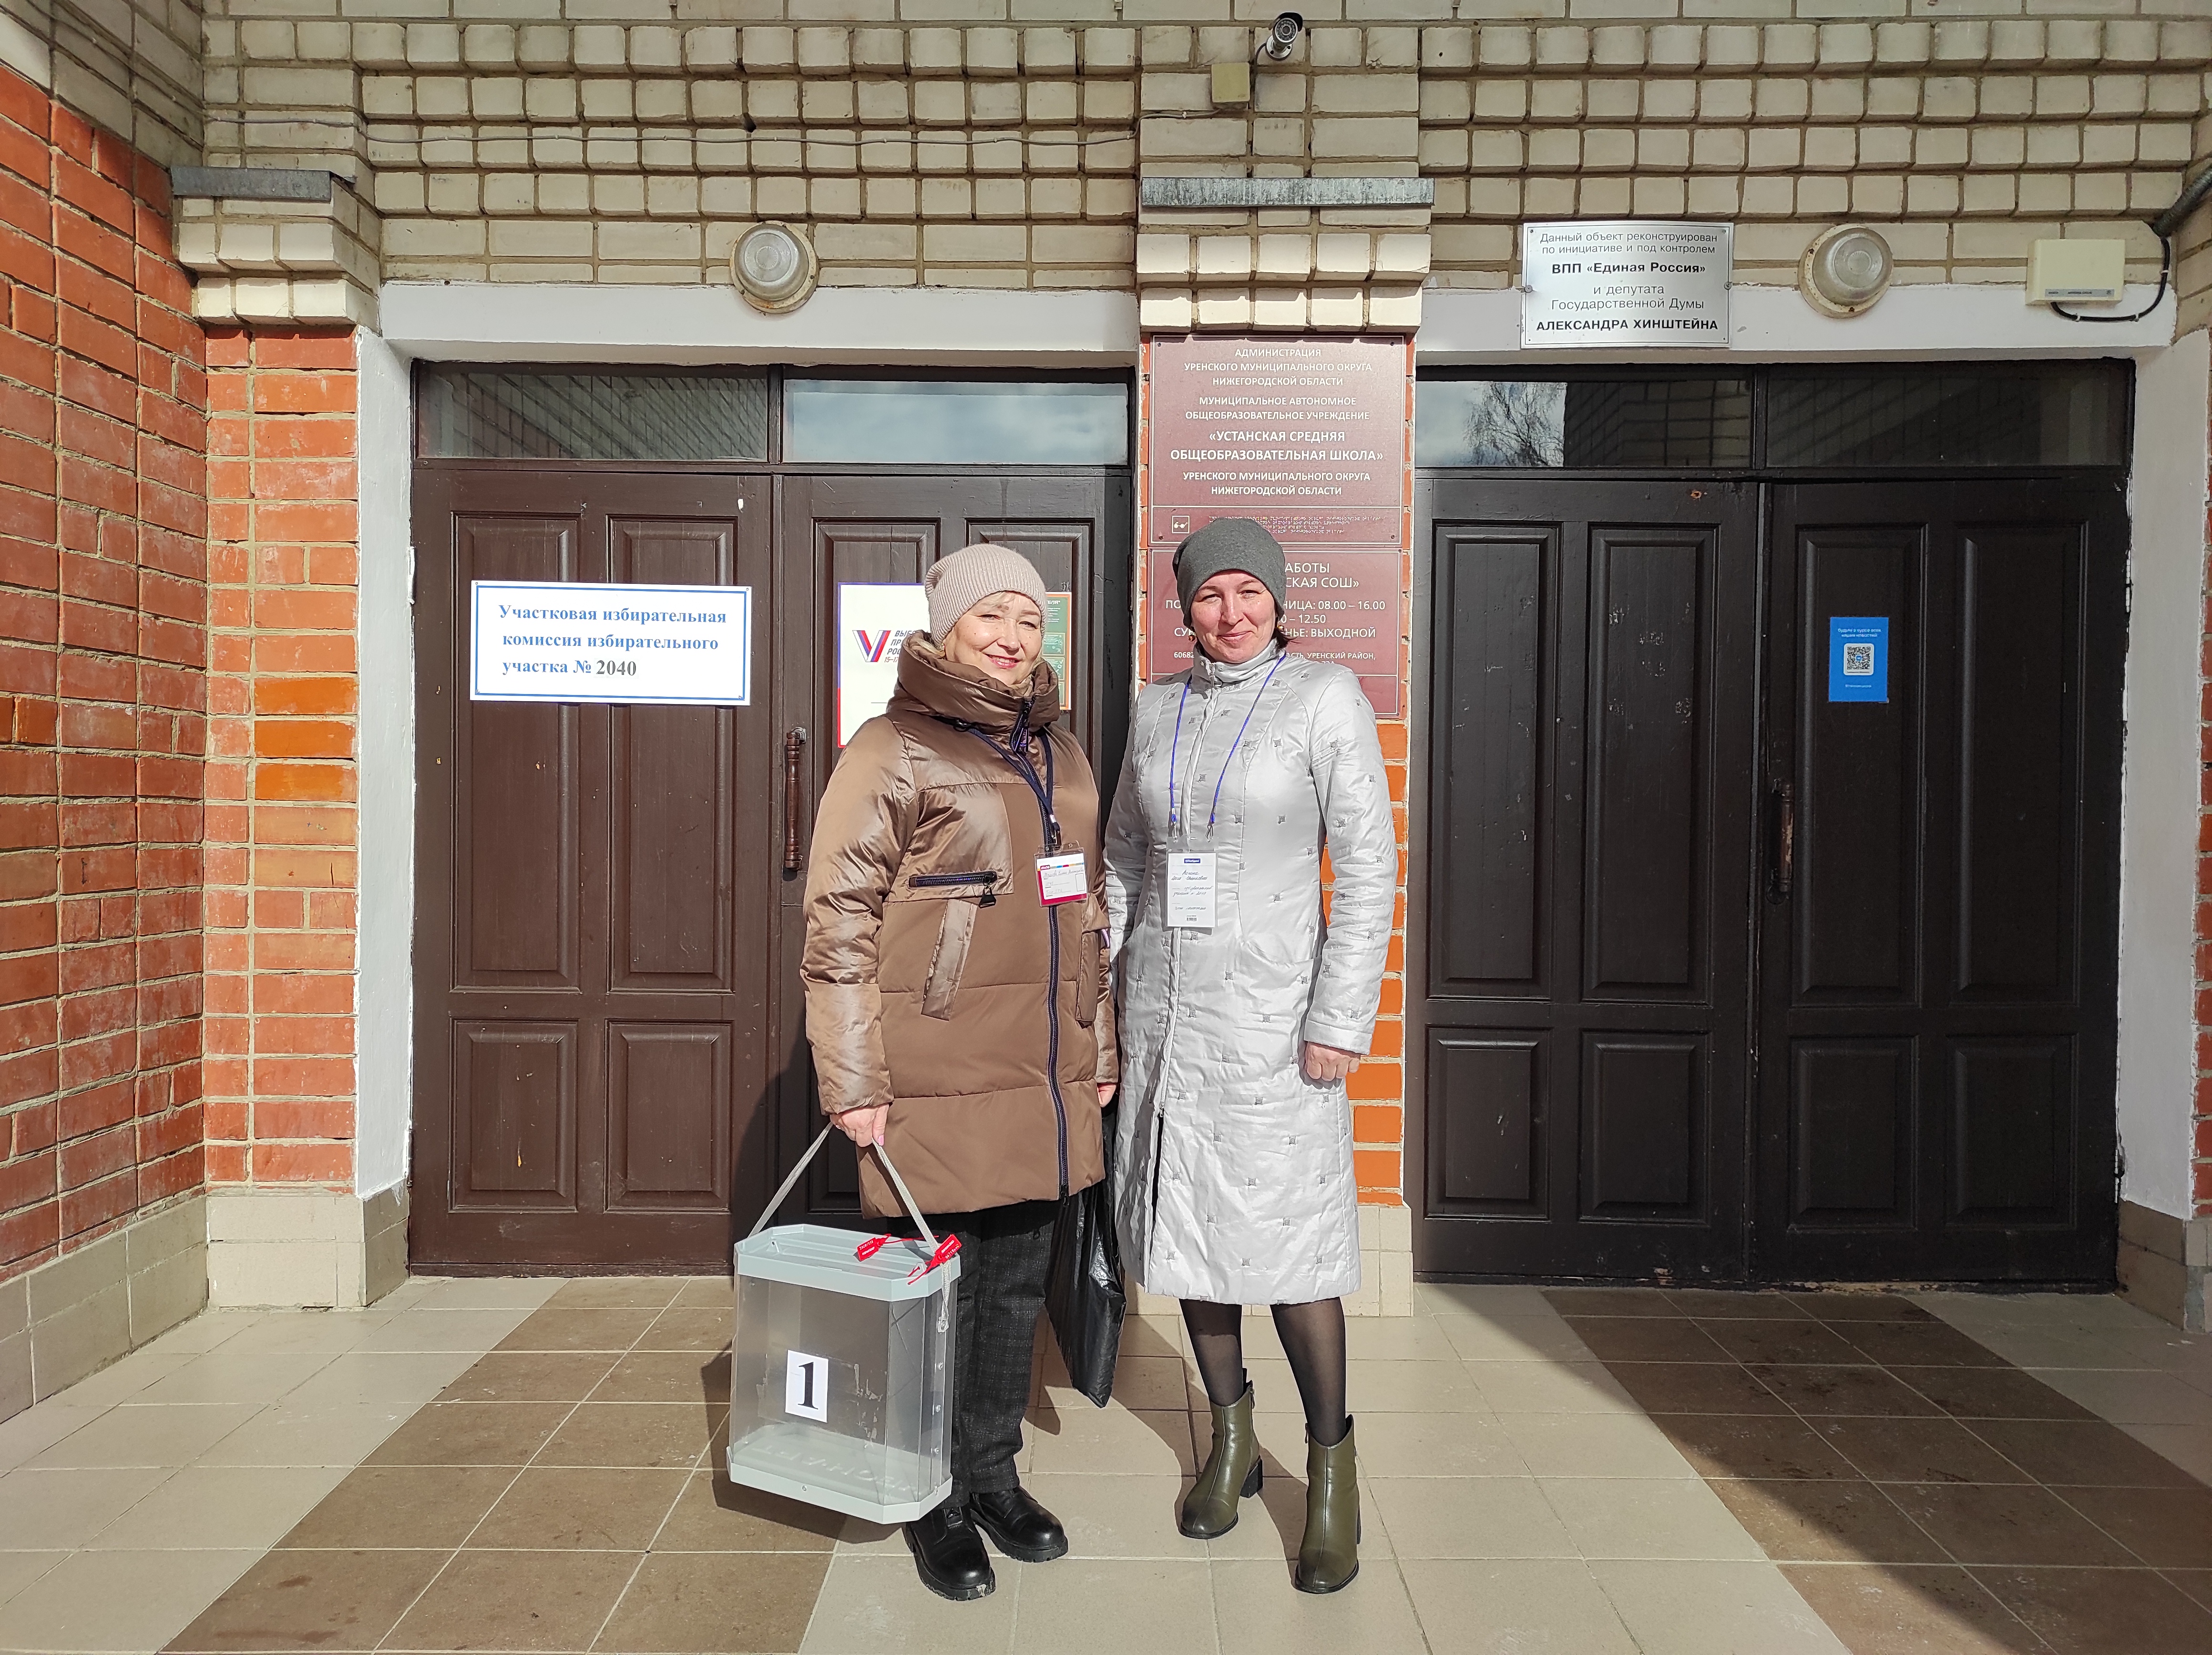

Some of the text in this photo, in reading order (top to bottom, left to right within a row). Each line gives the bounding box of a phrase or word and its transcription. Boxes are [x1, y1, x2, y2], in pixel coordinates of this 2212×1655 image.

[1540, 232, 1717, 244] Данный объект реконструирован
[1559, 245, 1622, 254] инициативе
[1661, 245, 1715, 254] контролем
[1552, 263, 1705, 274] ВПП «Единая Россия»
[1606, 286, 1664, 296] депутата
[1552, 298, 1703, 311] Государственной Думы
[1536, 318, 1718, 331] АЛЕКСАНДРА ХИНШТЕЙНА
[1235, 348, 1321, 358] АДМИНИСТРАЦИЯ
[1241, 363, 1334, 372] МУНИЦИПАЛЬНОГО
[1213, 376, 1342, 387] НИЖЕГОРОДСКОЙ ОБЛАСТИ
[1199, 396, 1287, 406] МУНИЦИПАЛЬНОЕ
[1186, 411, 1369, 421] ОБЩЕОБРАЗОВАТЕЛЬНОЕ УЧРЕЖДЕНИЕ
[1210, 431, 1344, 443] «УСТАНСКАЯ СРЕДНЯЯ
[1171, 450, 1383, 462] ОБЩЕОБРАЗОВАТЕЛЬНАЯ ШКОЛА»
[1183, 472, 1236, 480] УРЕНСКОГО
[1239, 472, 1332, 482] МУНИЦИПАЛЬНОГО
[1212, 485, 1295, 496] НИЖЕГОРОДСКОЙ
[1285, 563, 1330, 573] АБОТЫ
[1321, 577, 1359, 588] СОШ»
[1318, 601, 1346, 610] 08.00
[1359, 601, 1385, 610] 16.00
[499, 605, 726, 624] Участковая избирательная
[1299, 614, 1326, 623] 12.50
[1311, 627, 1376, 638] ВЫХОДНОЙ
[503, 634, 718, 651] комиссия избирательного
[503, 660, 636, 675] участка № 2040
[799, 1362, 819, 1410] 1
